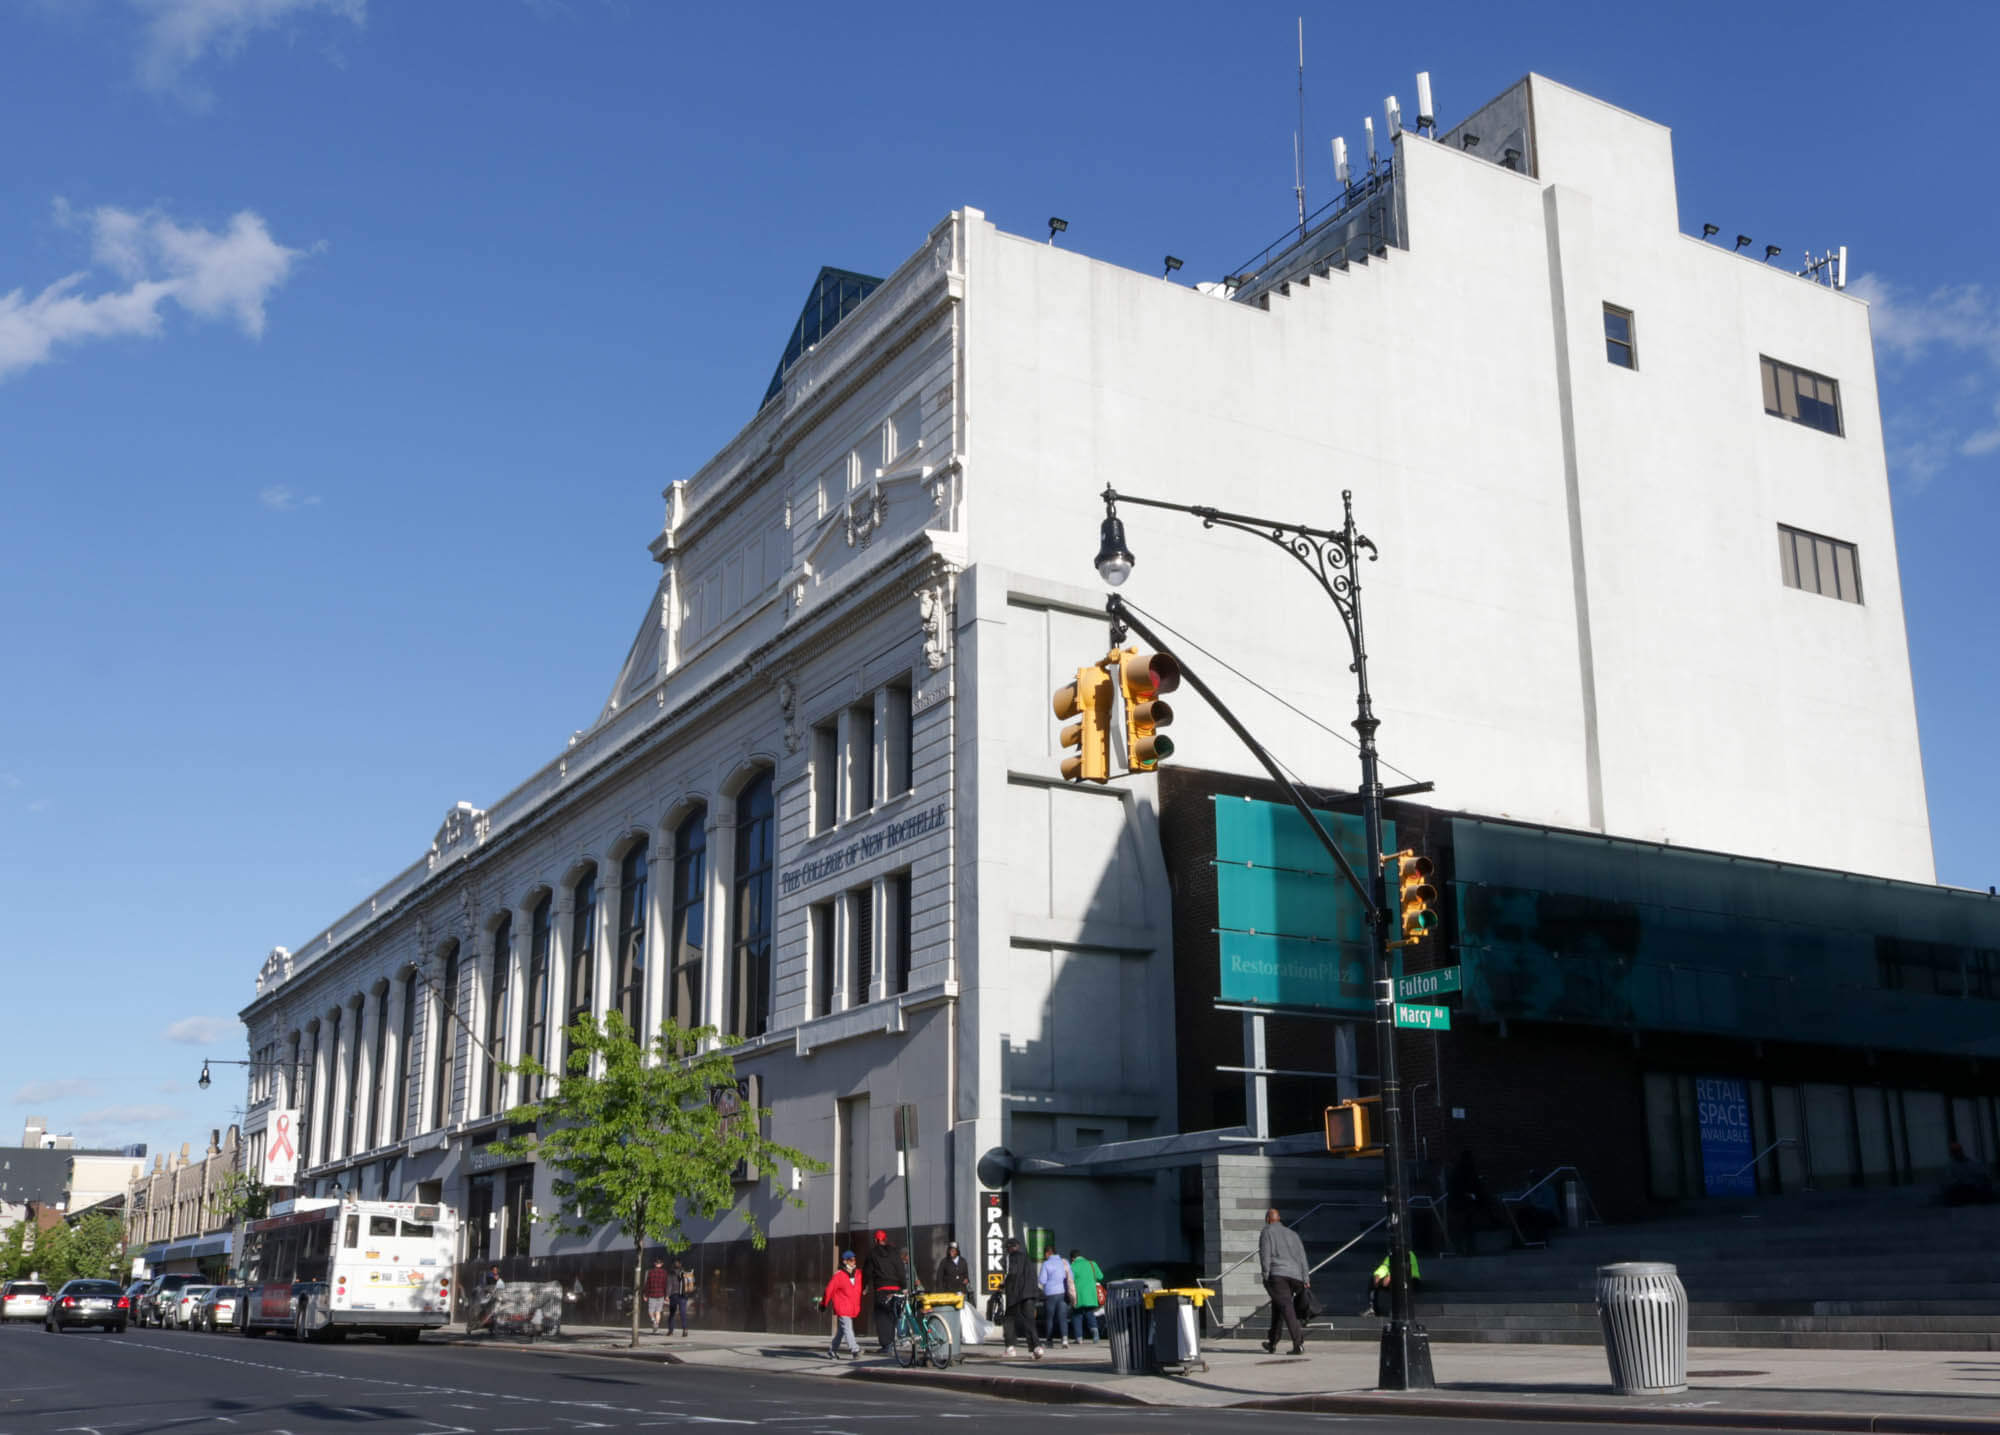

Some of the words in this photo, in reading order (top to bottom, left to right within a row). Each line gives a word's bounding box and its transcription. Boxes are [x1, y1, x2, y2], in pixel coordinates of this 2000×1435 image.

[783, 869, 800, 893] THE
[802, 849, 843, 885] COLLEGE
[845, 842, 859, 866] OF
[860, 830, 886, 860] NEW
[887, 803, 946, 849] ROCHELLE
[1400, 976, 1438, 997] Fulton
[1444, 969, 1452, 980] St
[1400, 1006, 1431, 1028] Marcy
[1434, 1007, 1443, 1018] Av
[1697, 1080, 1744, 1102] RETAIL
[1699, 1103, 1747, 1127] SPACE
[1702, 1128, 1749, 1144] AVAILABLE
[987, 1207, 1004, 1271] PARK
